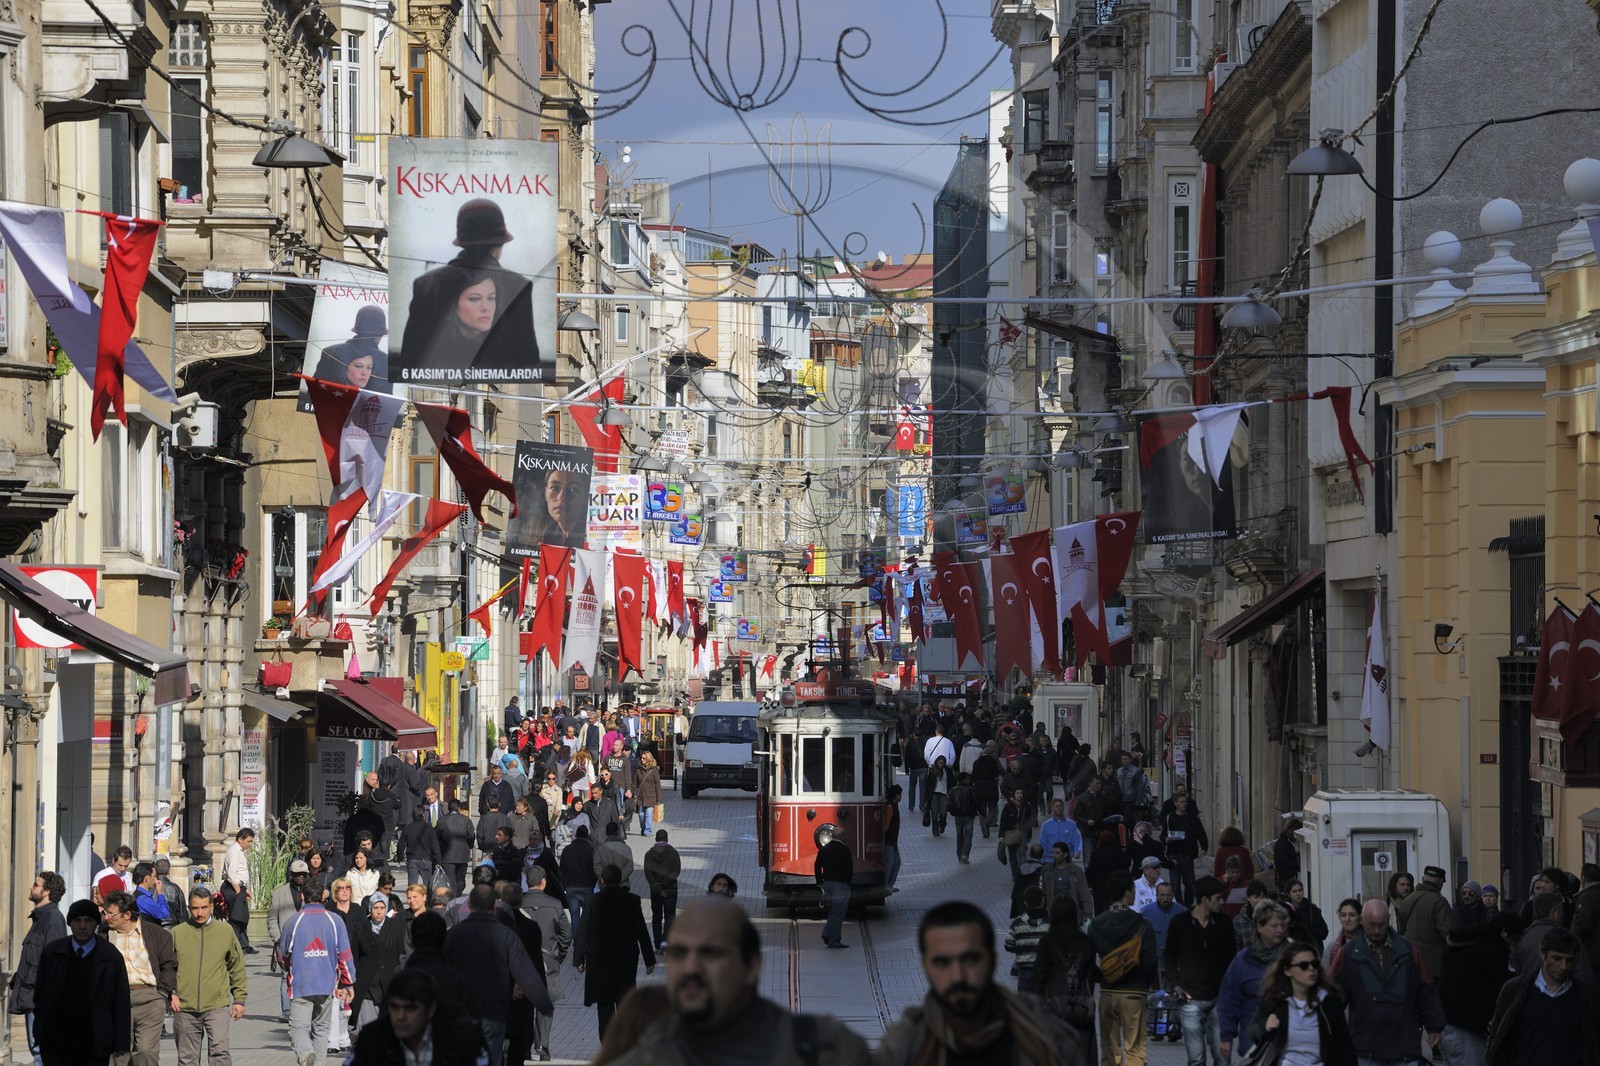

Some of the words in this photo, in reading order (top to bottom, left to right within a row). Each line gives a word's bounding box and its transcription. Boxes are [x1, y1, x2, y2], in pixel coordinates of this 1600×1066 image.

[397, 166, 554, 198] KISKANMAK
[402, 368, 409, 379] 6
[411, 368, 462, 380] KASIM'DA
[464, 366, 542, 380] SİNEMALARDA!
[518, 453, 589, 475] KISKANMAK
[589, 490, 639, 506] KİTAP
[645, 483, 682, 512] 3G
[987, 476, 1024, 504] 3G
[589, 508, 639, 521] FUARI
[671, 513, 701, 538] 3G
[720, 555, 746, 575] 3G
[711, 578, 733, 597] 3G
[826, 672, 830, 681] 1
[800, 686, 825, 697] TAKSİM
[836, 686, 859, 697] TÜNEL
[328, 725, 350, 737] SEA
[353, 726, 383, 739] CAFE
[608, 758, 623, 768] 1968
[303, 949, 328, 957] adidas
